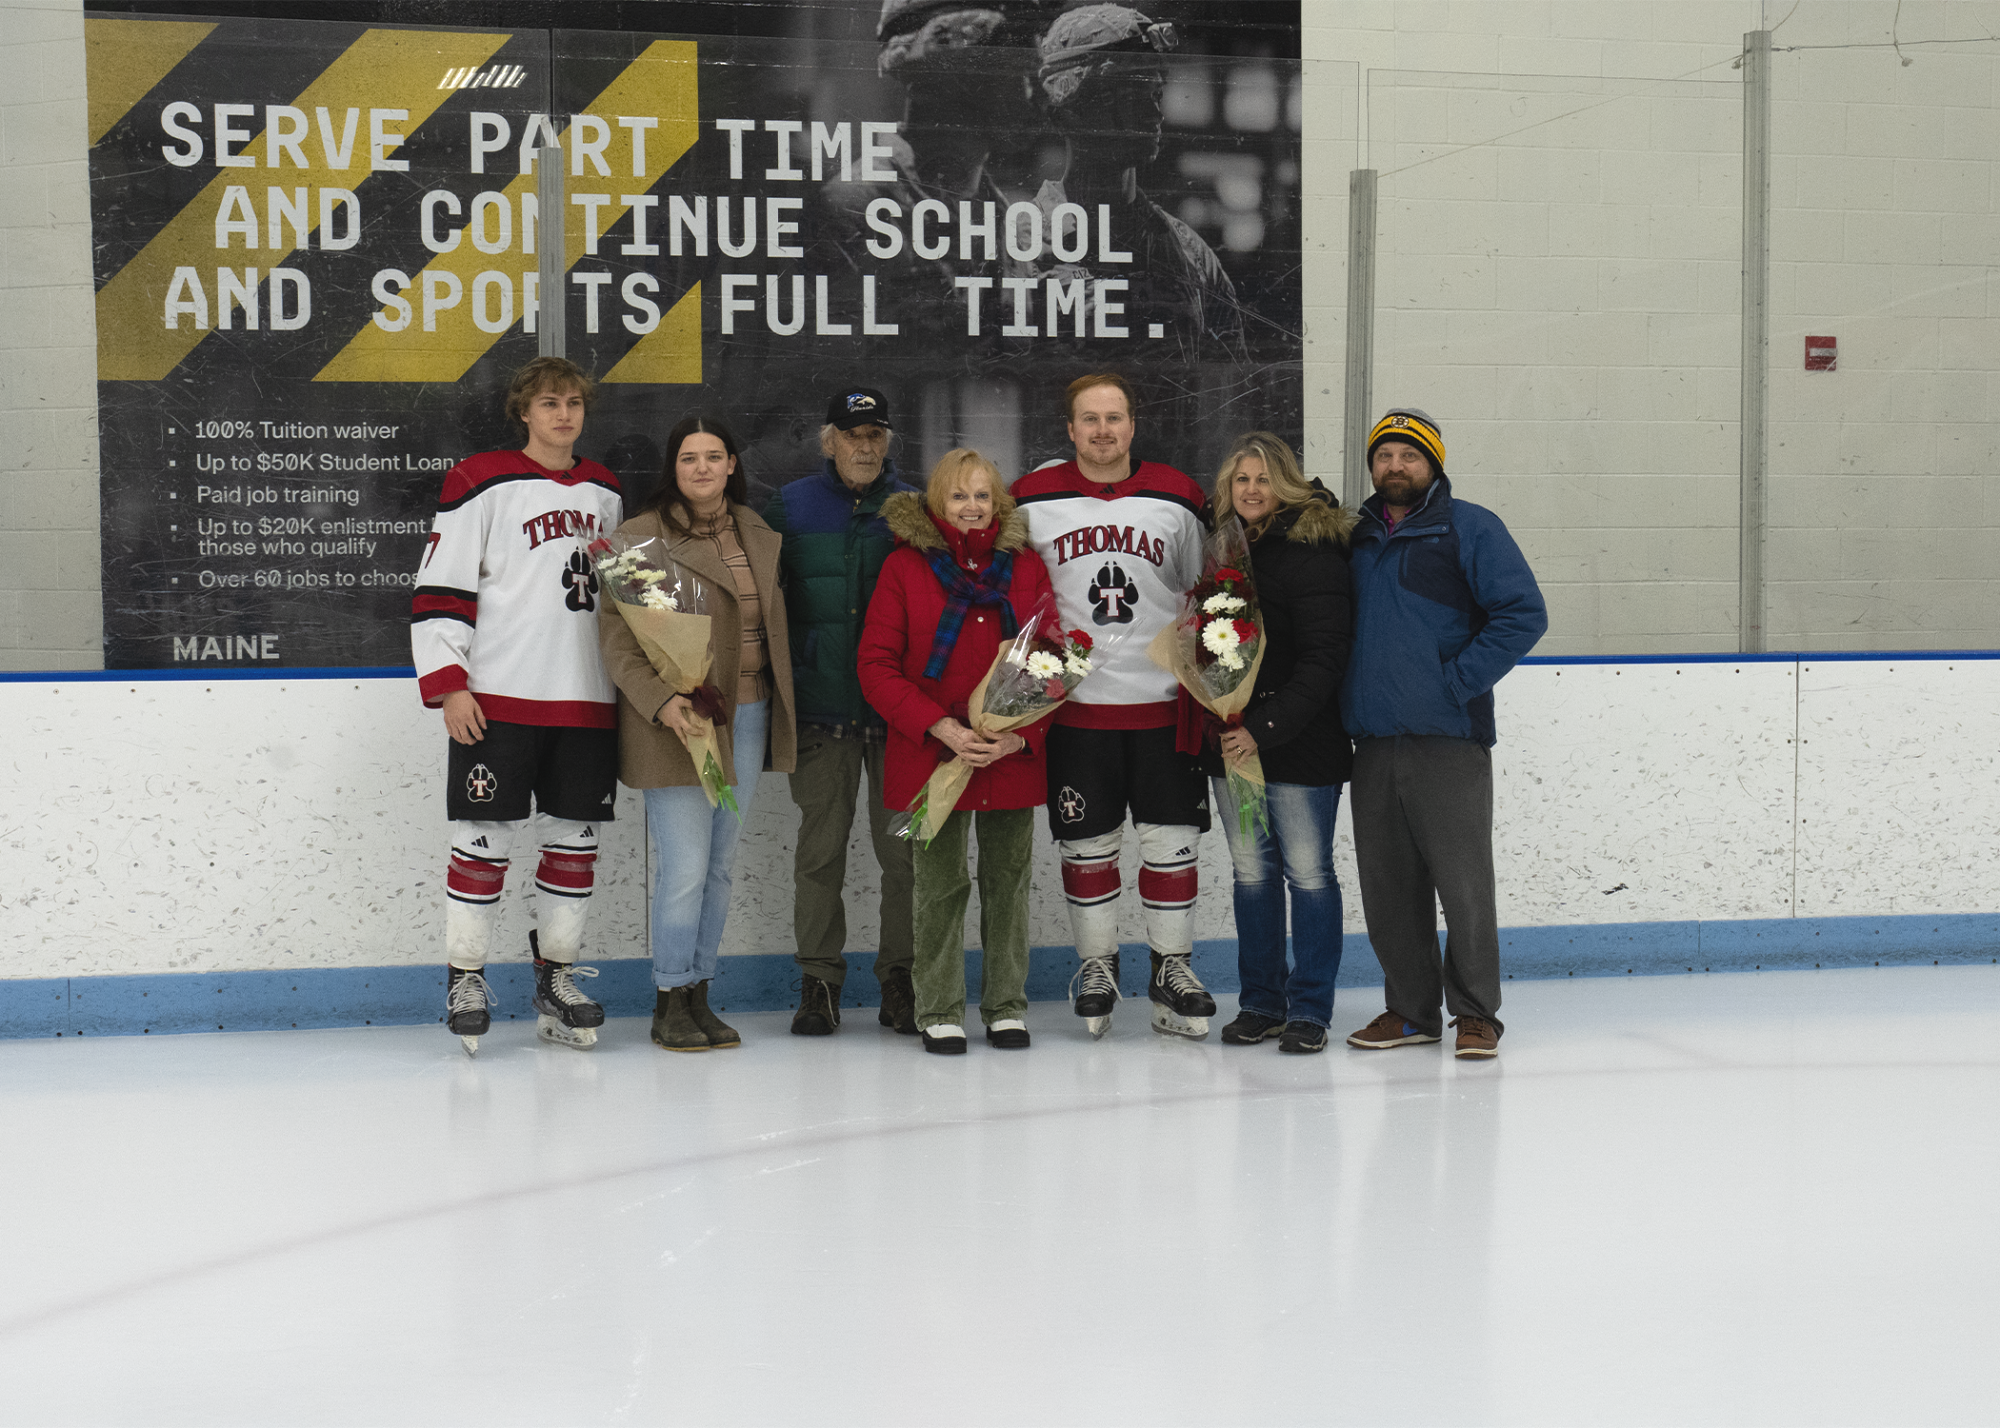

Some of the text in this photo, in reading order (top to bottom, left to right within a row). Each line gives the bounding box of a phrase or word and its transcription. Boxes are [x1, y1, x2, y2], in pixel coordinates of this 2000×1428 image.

[162, 101, 410, 172] SERVE
[716, 118, 899, 182] TIME
[215, 185, 361, 251] AND
[865, 197, 1134, 263] SCHOOL
[164, 266, 311, 331] AND
[721, 274, 900, 336] FULL
[954, 276, 1165, 338] TIME.
[195, 421, 399, 439] 100% Tuition waiver
[196, 453, 225, 474] Up
[230, 455, 251, 471] to
[256, 452, 314, 473] $50K
[319, 453, 400, 471] Student
[406, 453, 455, 471] Loan
[197, 486, 359, 507] Paid job training
[198, 518, 226, 539] Up
[232, 519, 252, 535] to
[258, 517, 315, 536] $20K
[321, 517, 427, 535] enlistment
[198, 537, 377, 558] those who qualify
[1053, 524, 1165, 568] THOMAS
[199, 570, 248, 588] Over
[254, 570, 282, 588] 60
[286, 569, 330, 590] jobs
[335, 571, 355, 587] to
[571, 573, 590, 604] T
[1099, 587, 1125, 617] T
[173, 634, 280, 662] MAINE
[472, 779, 488, 797] T
[1063, 800, 1077, 817] T
